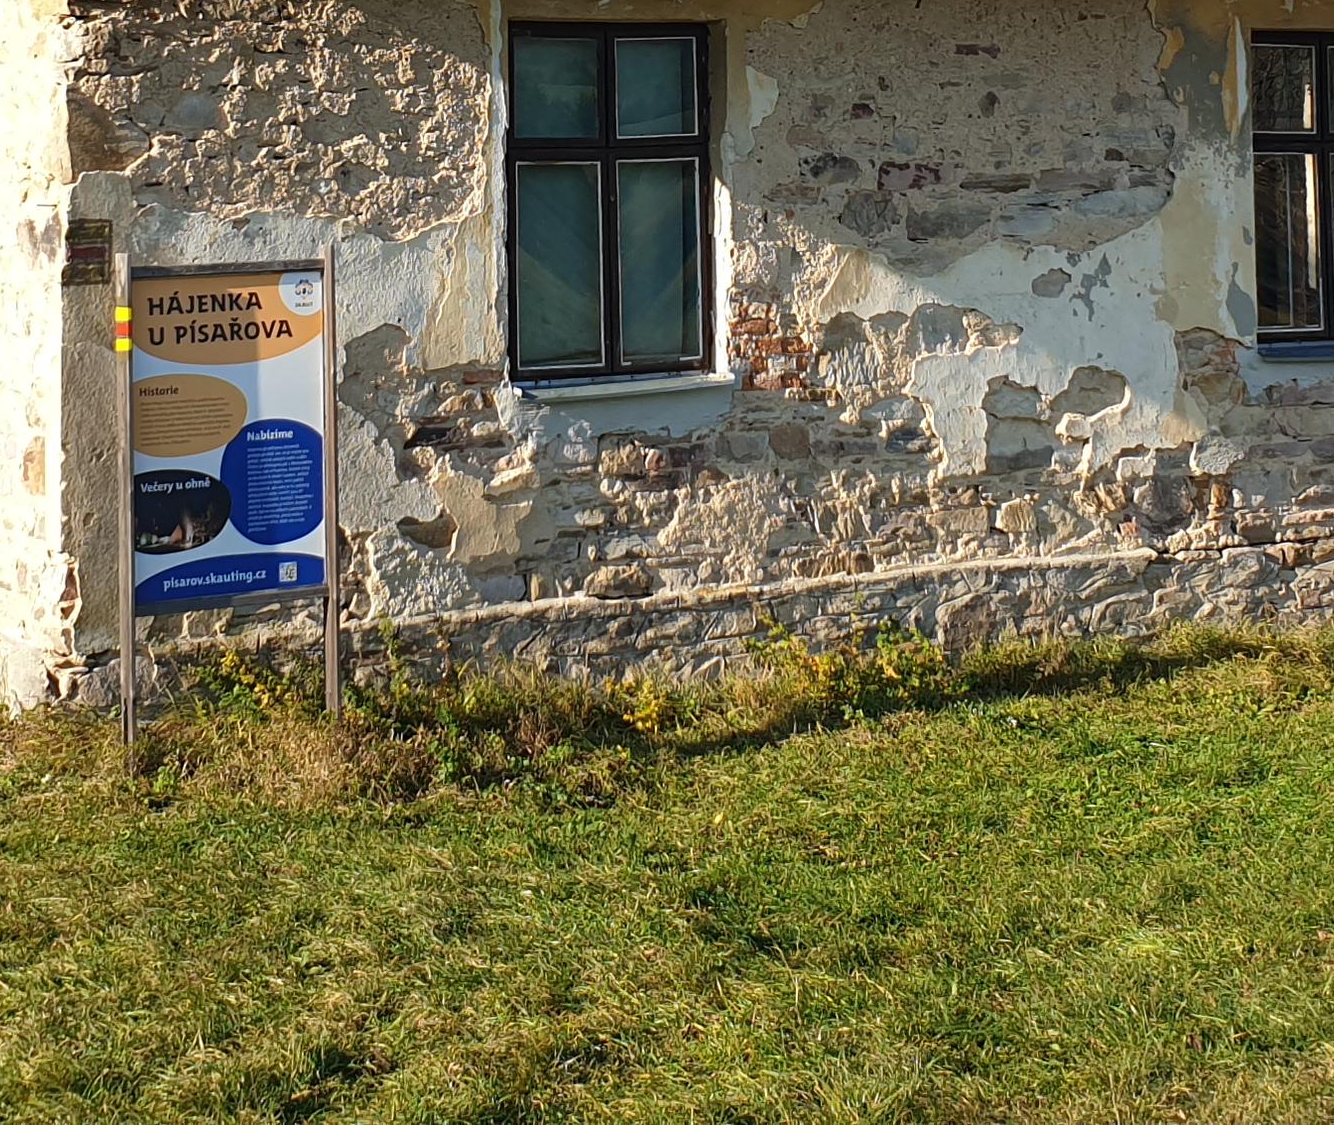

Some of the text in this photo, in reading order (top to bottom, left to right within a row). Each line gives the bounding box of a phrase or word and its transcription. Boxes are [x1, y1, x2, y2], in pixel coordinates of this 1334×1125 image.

[147, 291, 262, 316] HÁJENKA
[148, 317, 293, 346] U PÍSAŘOVA
[139, 385, 179, 397] Historie
[247, 428, 294, 442] Nabízíme
[140, 477, 211, 494] Večery u ohně
[163, 569, 267, 592] pisarov.skauting.cz
